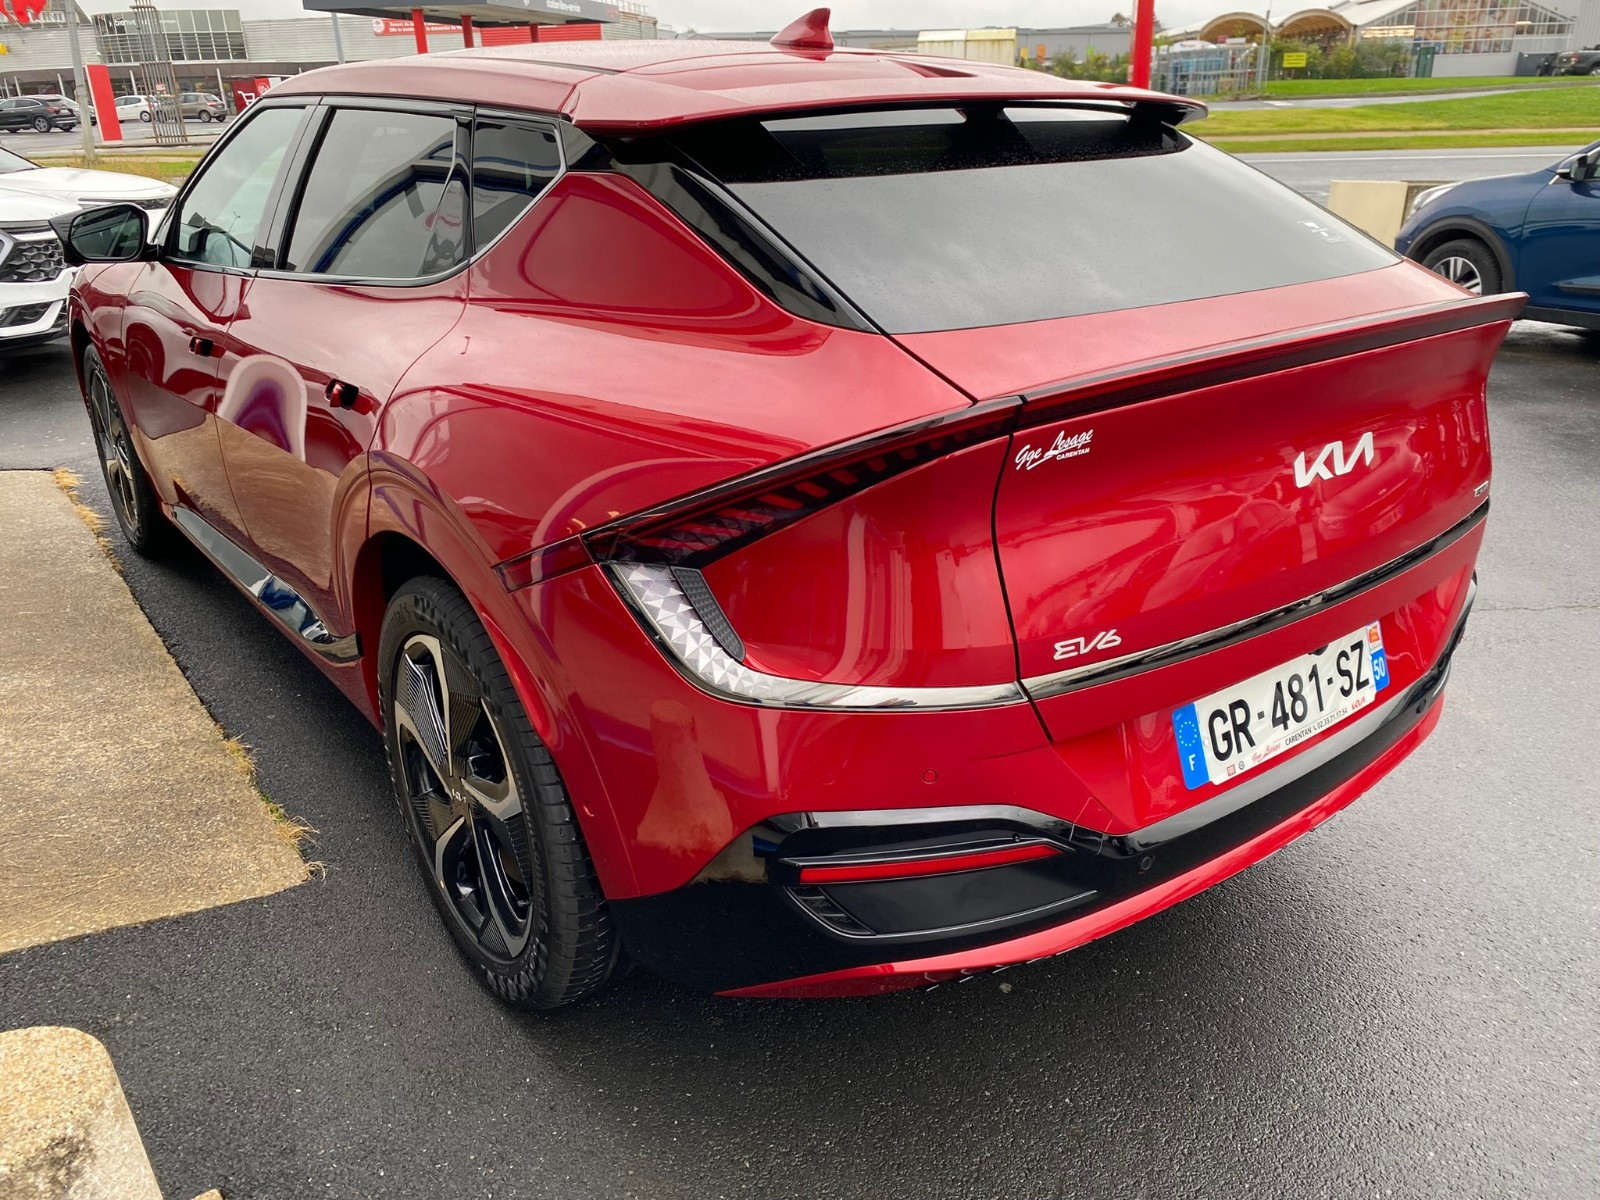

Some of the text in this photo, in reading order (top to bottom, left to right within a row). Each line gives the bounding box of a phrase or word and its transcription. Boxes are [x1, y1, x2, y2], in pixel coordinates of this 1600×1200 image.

[1015, 429, 1094, 470] Gge Lesage
[1056, 447, 1090, 460] CARENTAN
[1053, 628, 1122, 660] EV6
[1373, 656, 1386, 681] 50
[1208, 639, 1370, 762] GR-481-SZ
[1285, 727, 1312, 746] CARENTAN
[1188, 754, 1196, 771] F
